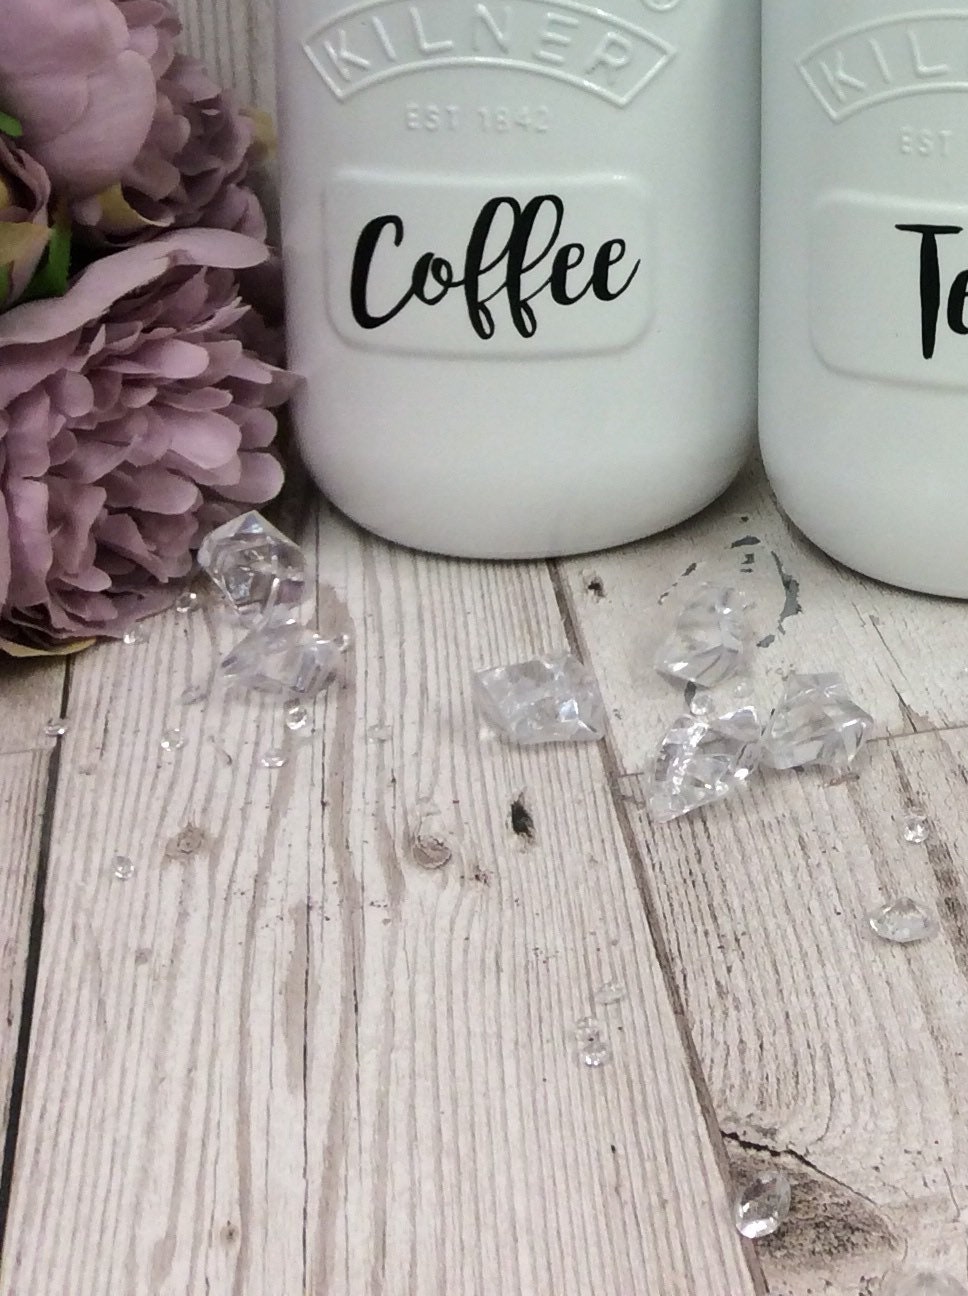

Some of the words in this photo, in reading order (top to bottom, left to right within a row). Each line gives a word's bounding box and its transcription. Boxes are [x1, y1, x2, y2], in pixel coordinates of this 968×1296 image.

[323, 3, 634, 86] KILNER
[404, 103, 459, 132] EST
[476, 104, 550, 135] 1842
[900, 127, 953, 156] EST
[350, 194, 641, 340] Coffee
